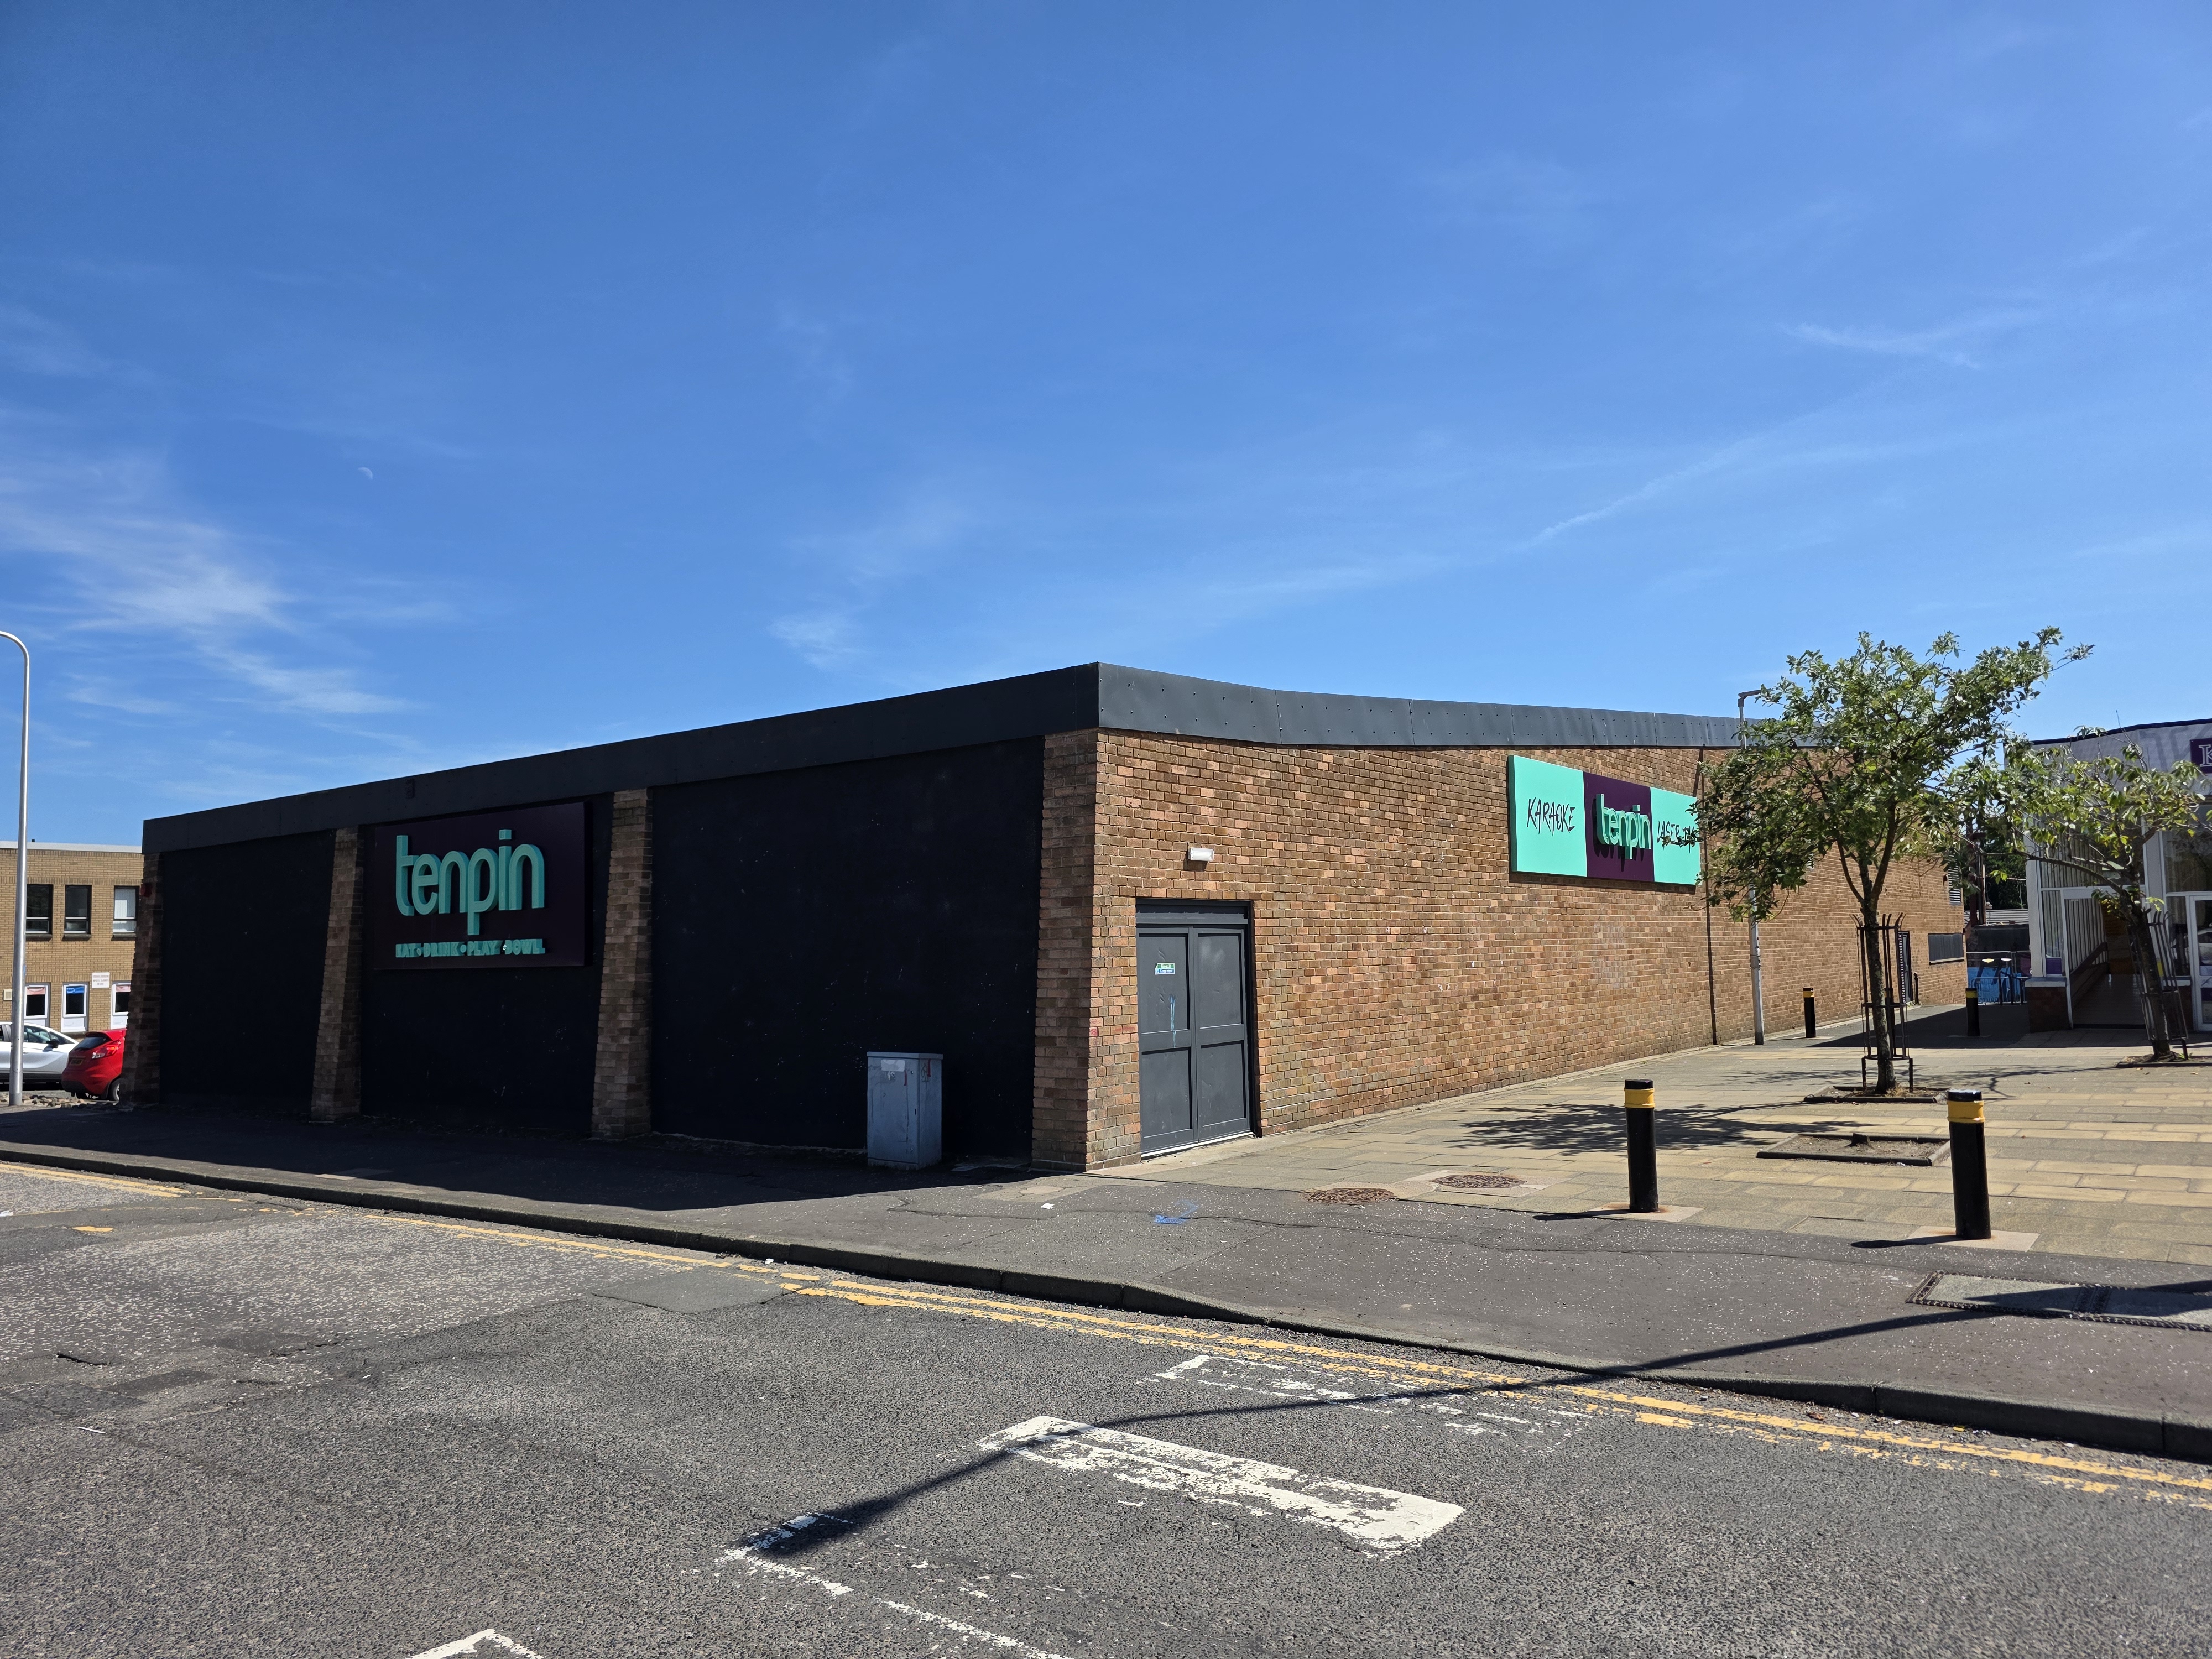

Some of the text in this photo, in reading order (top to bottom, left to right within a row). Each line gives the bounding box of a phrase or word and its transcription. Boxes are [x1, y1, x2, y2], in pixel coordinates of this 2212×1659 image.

[1527, 797, 1575, 836] KARAOKE
[1596, 794, 1651, 859] tenpin
[1657, 821, 1681, 850] LASER
[396, 829, 544, 935] tenpin
[395, 939, 545, 958] EAT DRINK PLAY BOWL
